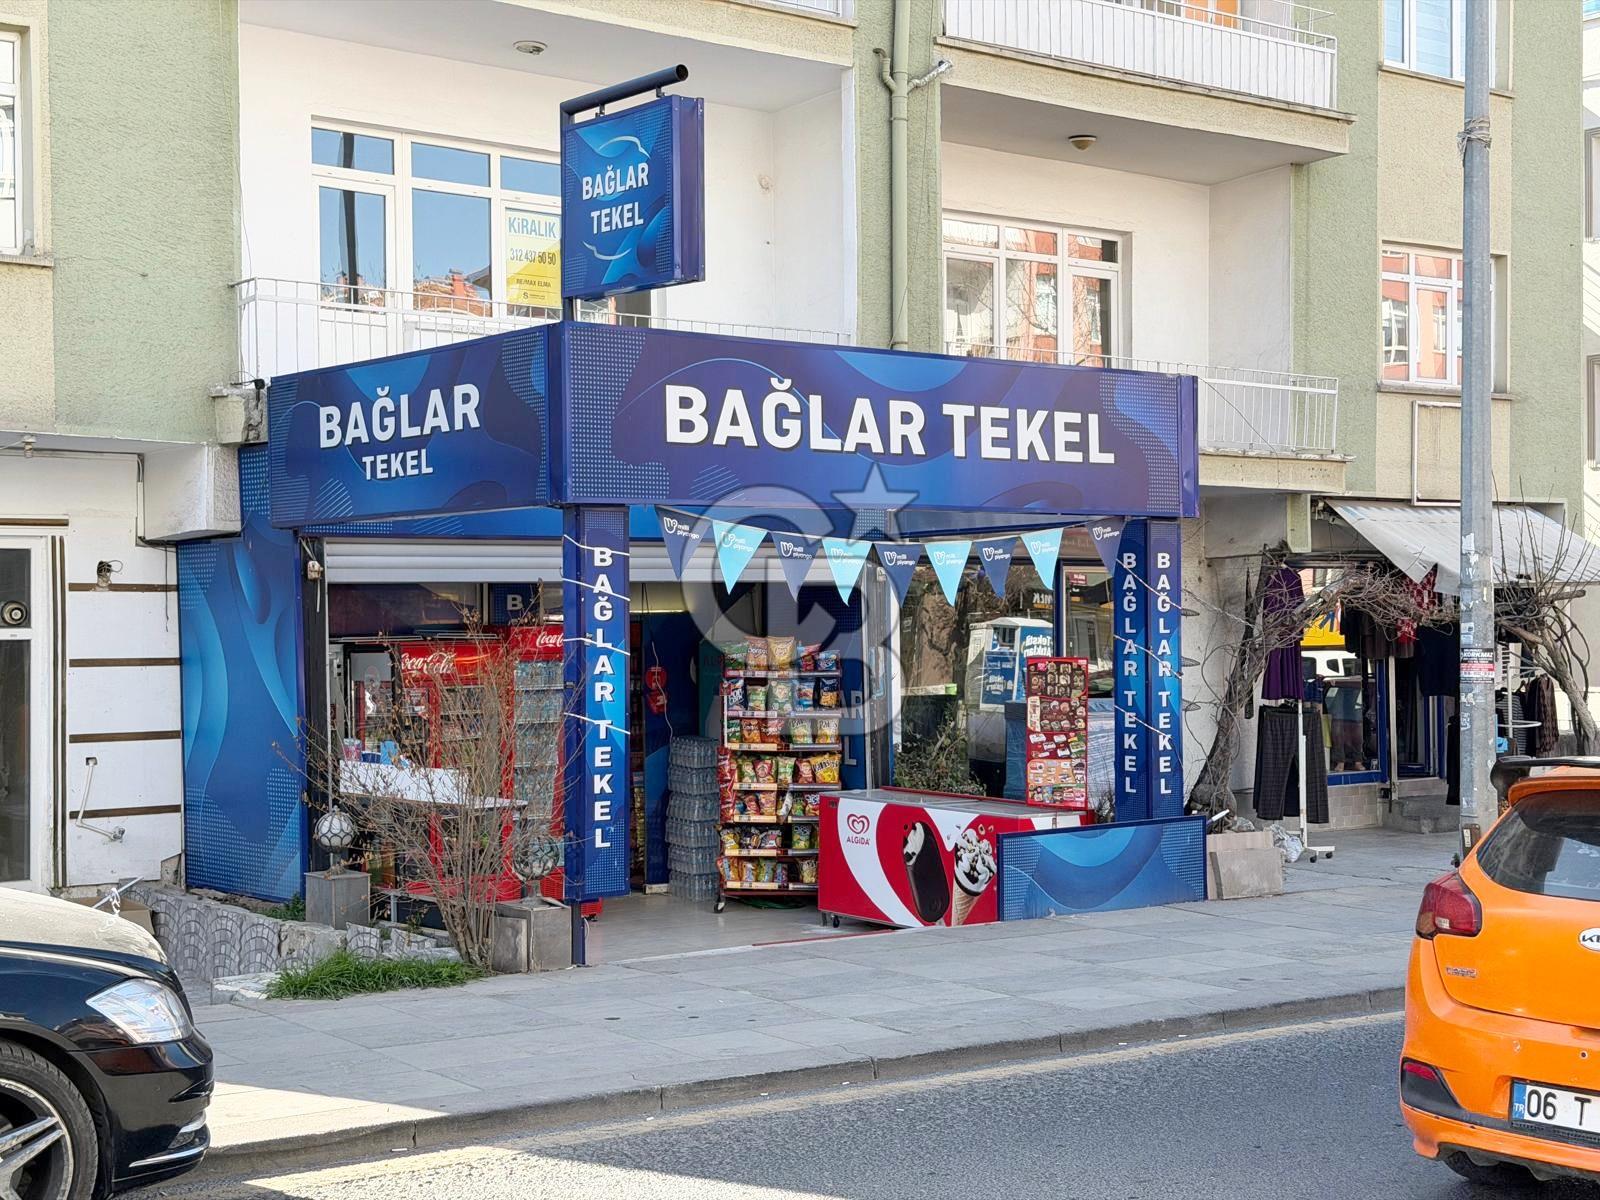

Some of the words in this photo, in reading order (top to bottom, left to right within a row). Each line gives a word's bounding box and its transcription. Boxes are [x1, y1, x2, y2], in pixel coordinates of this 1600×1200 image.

[582, 162, 649, 200] BAĞLAR
[590, 202, 644, 234] TEKEL
[510, 248, 524, 262] 312
[524, 249, 536, 264] 437
[537, 251, 547, 265] 50
[547, 252, 557, 266] 50
[319, 383, 481, 449] BAĞLAR
[665, 377, 926, 456] BAĞLAR
[942, 403, 1116, 465] TEKEL
[362, 448, 434, 481] TEKEL
[592, 546, 615, 703] BAĞLAR
[1122, 552, 1139, 677] BAĞLAR
[1157, 552, 1171, 678] BAĞLAR
[1123, 690, 1138, 794] TEKEL
[1158, 690, 1172, 795] TEKEL
[593, 719, 614, 849] TEKEL
[1582, 934, 1600, 943] KI
[1514, 1103, 1525, 1113] TR
[1527, 1089, 1557, 1120] 06
[1574, 1096, 1592, 1126] T
